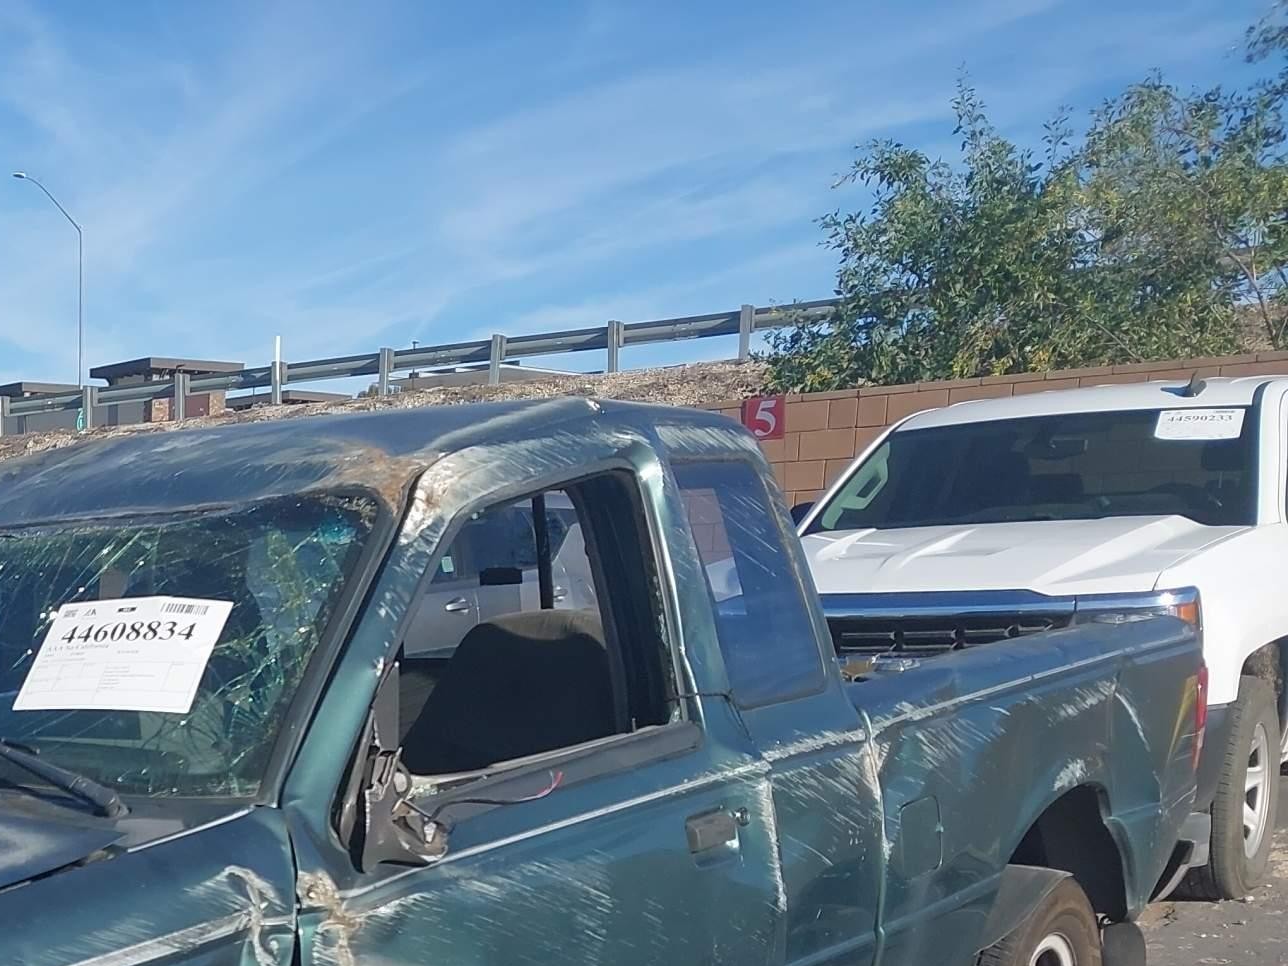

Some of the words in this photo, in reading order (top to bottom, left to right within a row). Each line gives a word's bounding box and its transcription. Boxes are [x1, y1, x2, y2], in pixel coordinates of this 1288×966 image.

[754, 400, 777, 437] 5
[1167, 414, 1233, 422] 44590233
[62, 620, 197, 644] 44608834
